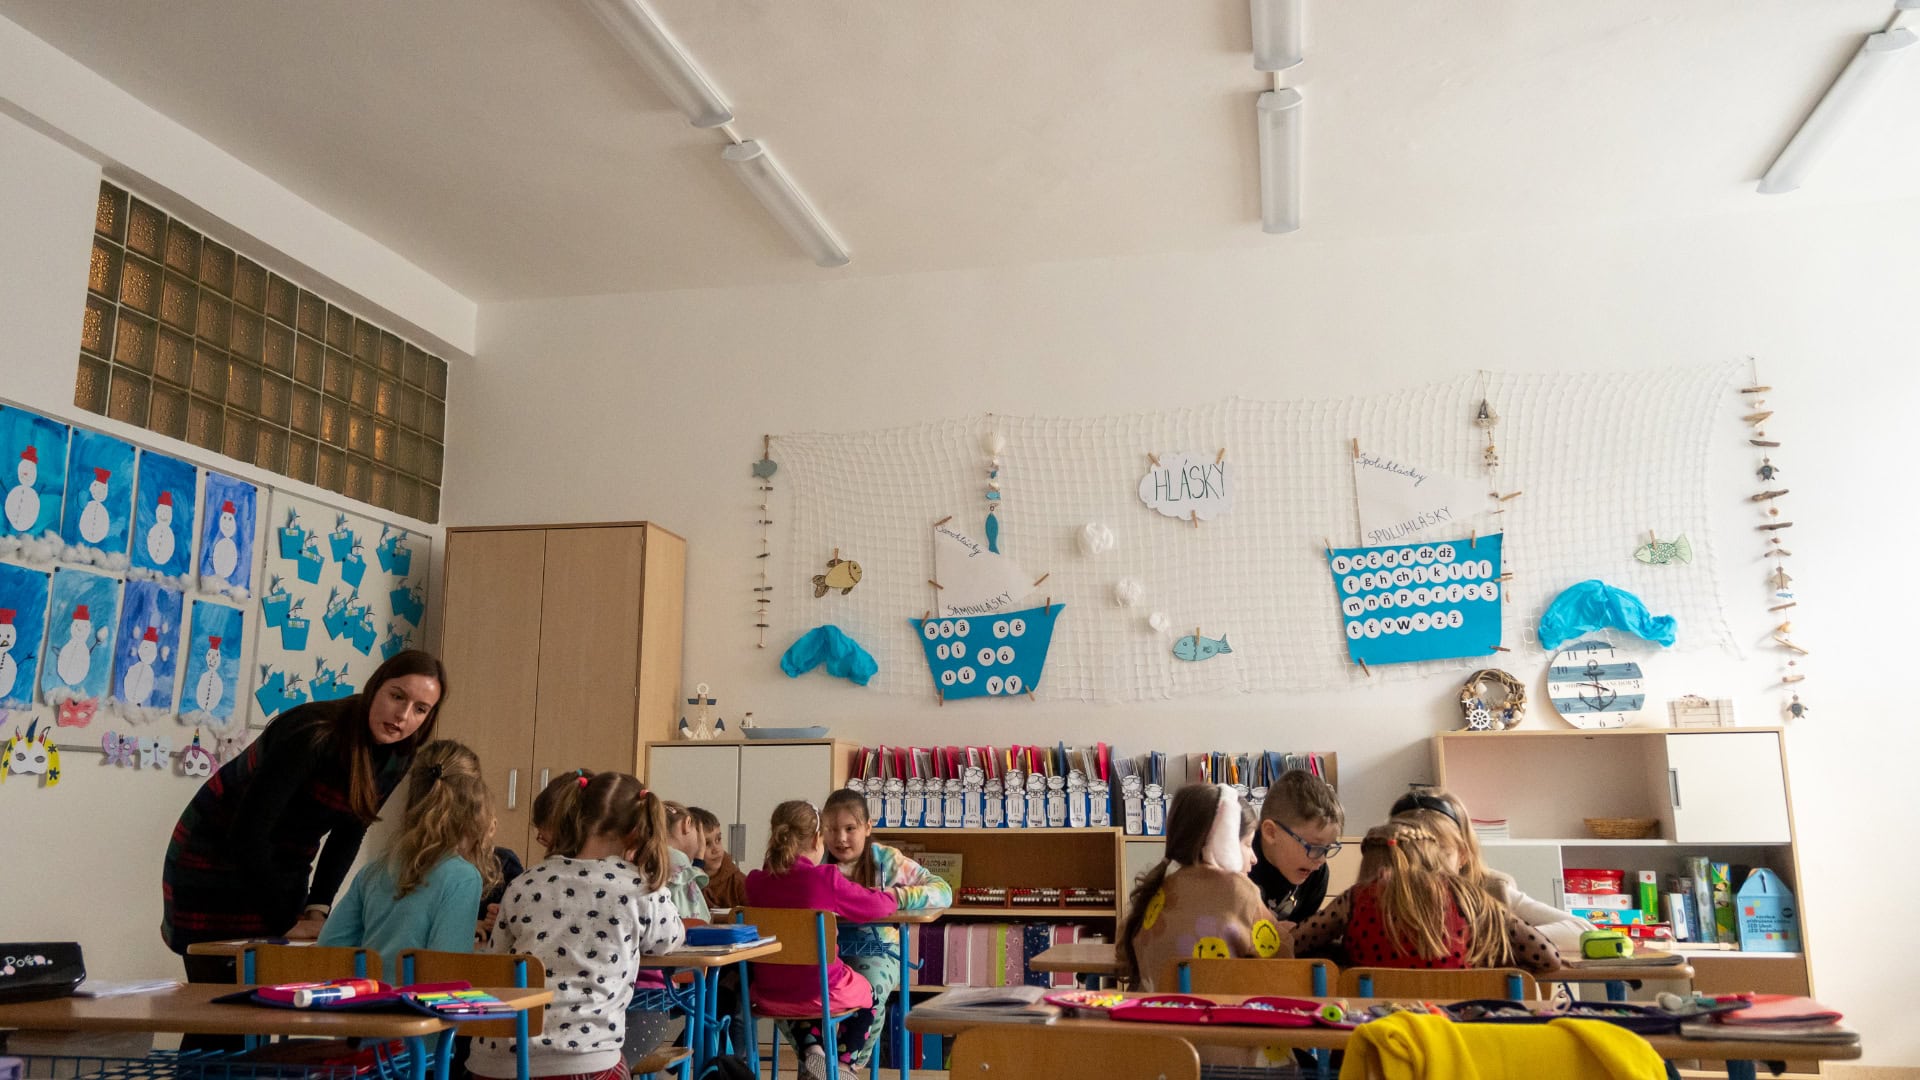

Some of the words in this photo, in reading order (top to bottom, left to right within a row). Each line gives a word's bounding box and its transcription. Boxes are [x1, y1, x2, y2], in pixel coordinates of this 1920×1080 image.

[1154, 459, 1225, 502] HLÁSKY
[1368, 507, 1454, 545] SPOLUHLÁSKY
[1337, 560, 1346, 570] b
[1356, 558, 1362, 566] c
[1370, 555, 1377, 565] č
[1386, 553, 1394, 563] d
[1401, 551, 1411, 561] ď
[1420, 548, 1433, 558] dz
[1438, 547, 1452, 558] dž
[1348, 580, 1353, 590] f
[1364, 577, 1372, 587] g
[1379, 575, 1387, 584] h
[1396, 572, 1410, 582] ch
[1416, 570, 1422, 581] j
[1433, 567, 1440, 577] k
[946, 592, 1013, 617] SAMOHLÁSKY
[1349, 602, 1360, 612] m
[1383, 595, 1391, 605] ň
[1400, 594, 1408, 604] p
[1418, 593, 1425, 602] q
[1469, 588, 1475, 596] s
[1486, 586, 1492, 596] š
[998, 625, 1006, 633] e
[1015, 621, 1022, 631] é
[1352, 625, 1358, 634] t
[1384, 621, 1391, 629] v
[1437, 616, 1443, 624] z
[1451, 613, 1457, 624] ž
[929, 627, 936, 635] a
[1586, 645, 1597, 654] 12
[983, 652, 991, 660] o
[1001, 650, 1009, 661] ó
[1567, 650, 1577, 661] 11
[1556, 666, 1568, 675] 10
[1624, 662, 1632, 671] 2
[944, 673, 952, 681] u
[963, 669, 970, 680] ú
[991, 681, 999, 692] y
[1009, 678, 1017, 691] ý
[1633, 680, 1640, 689] 3
[1564, 703, 1571, 713] 8
[1617, 712, 1625, 722] 5
[1599, 720, 1606, 728] 6
